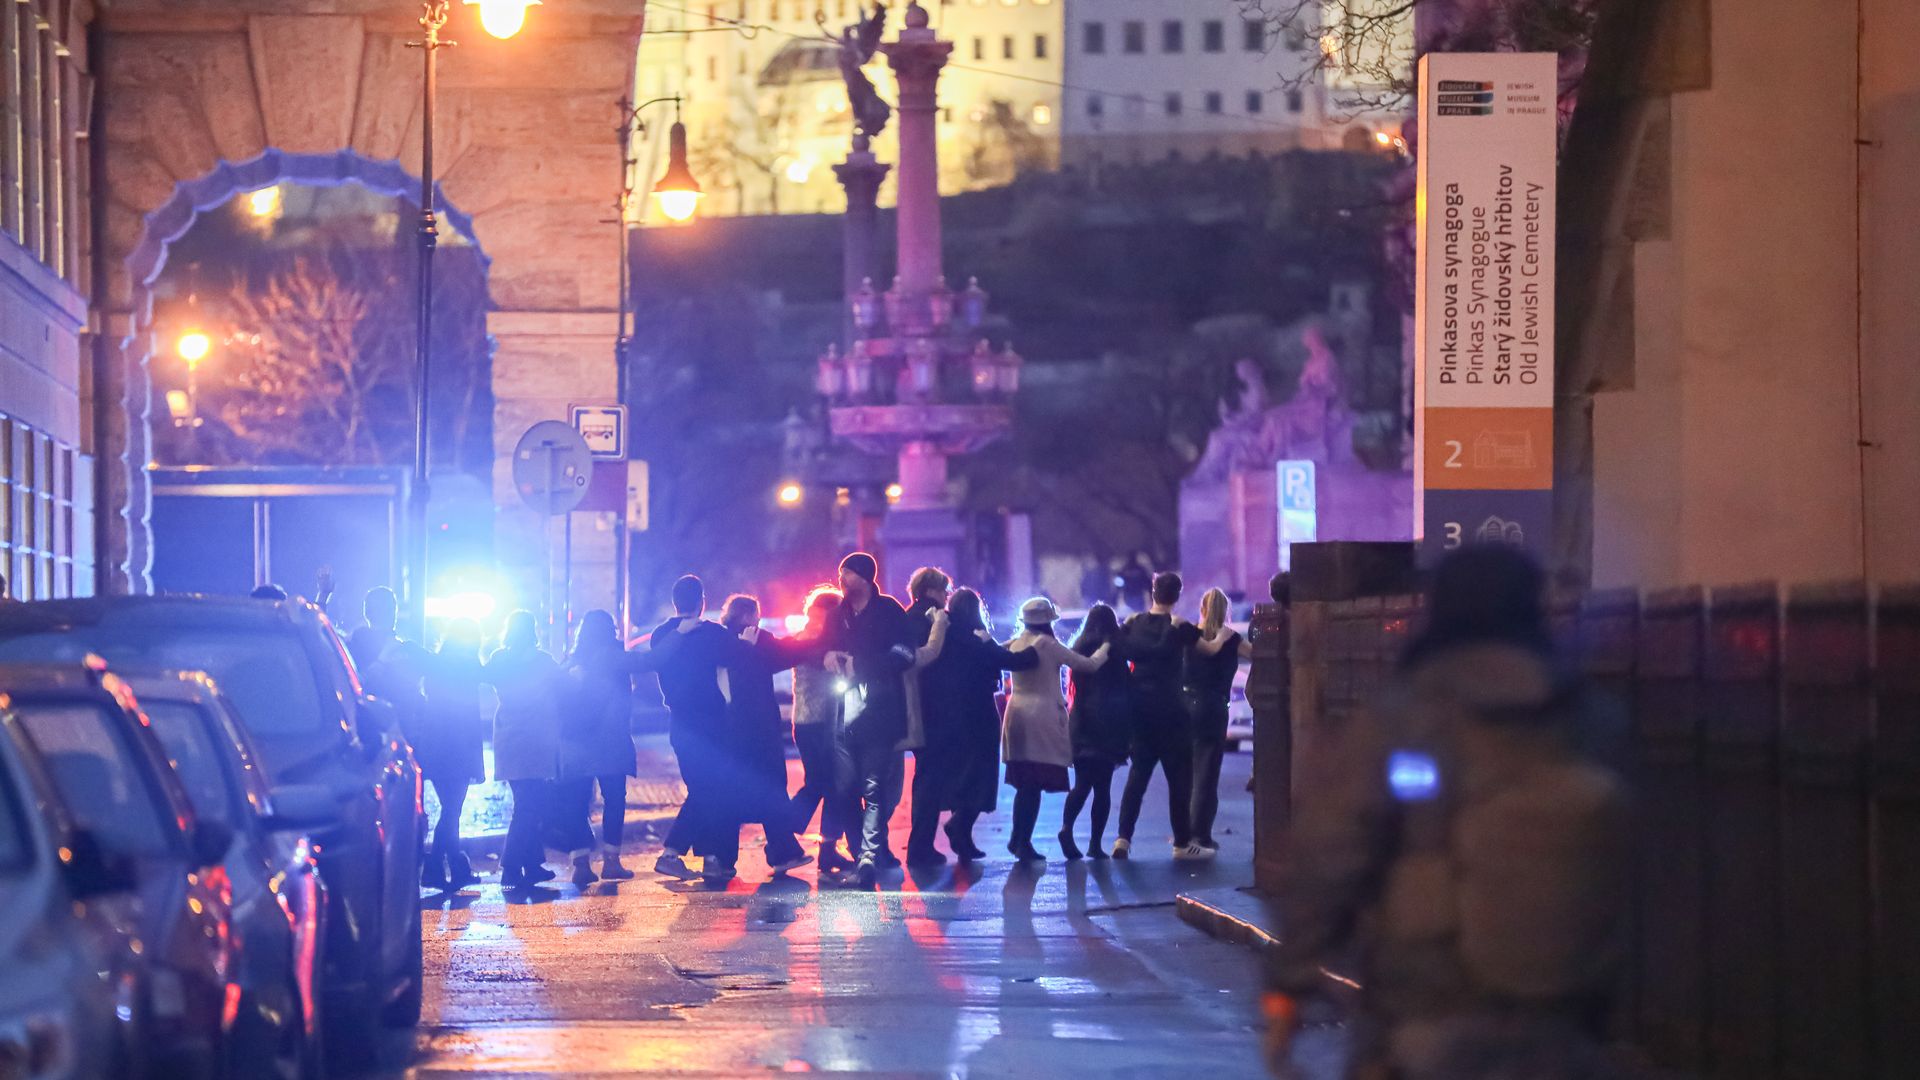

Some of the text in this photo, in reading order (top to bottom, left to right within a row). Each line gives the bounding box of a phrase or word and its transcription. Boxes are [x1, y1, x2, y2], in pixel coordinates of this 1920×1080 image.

[1440, 182, 1464, 384] Pinkasova synagoga
[1466, 206, 1490, 384] Pinkas Synagogue
[1493, 164, 1516, 385] Starý židovský hřbitov
[1520, 182, 1544, 385] Old Jewish Cemetery
[1443, 522, 1462, 549] 3
[1444, 440, 1463, 468] 2
